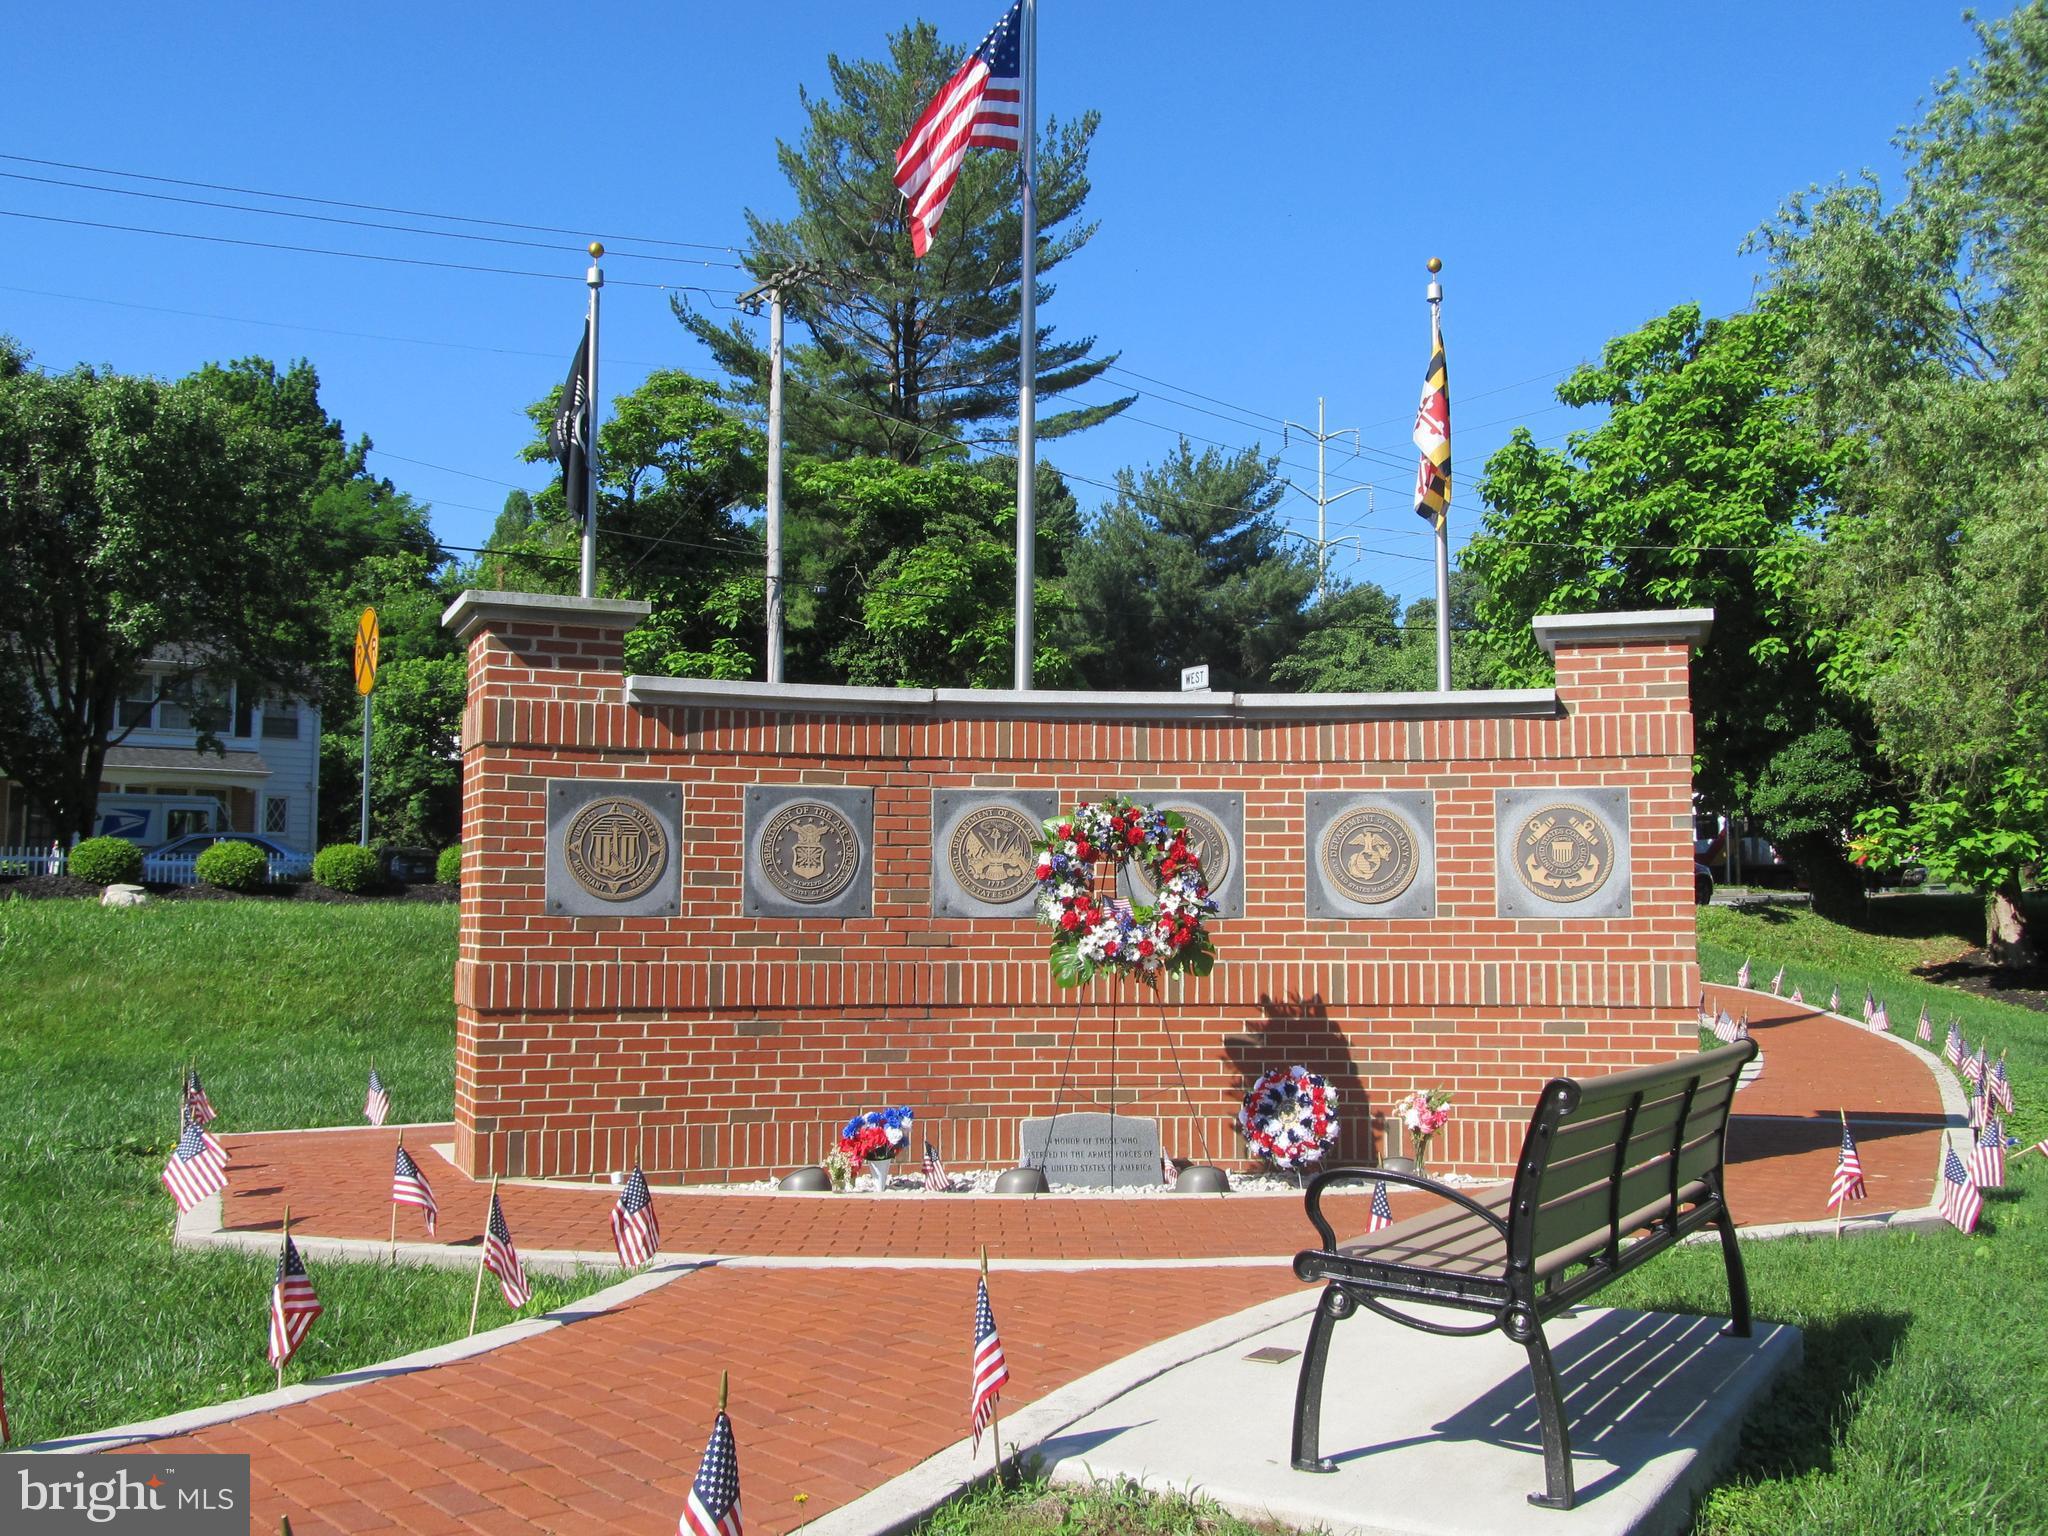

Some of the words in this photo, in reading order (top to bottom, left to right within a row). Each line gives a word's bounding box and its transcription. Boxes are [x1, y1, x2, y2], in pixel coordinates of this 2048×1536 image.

[1185, 670, 1204, 685] WEST
[573, 810, 598, 837] UNITED
[631, 809, 657, 837] STATES
[952, 809, 993, 849] DEPARTMENT
[997, 809, 1008, 817] OF
[1011, 813, 1027, 827] THE
[1192, 818, 1206, 831] THE
[1206, 828, 1220, 848] NAVY
[1330, 814, 1376, 858] DEPARTMENT
[1386, 822, 1398, 833] THE
[1397, 832, 1410, 858] NAVY
[763, 810, 793, 866] DEPARTMENT
[795, 806, 809, 815] OF
[813, 807, 834, 820] THE
[833, 819, 850, 837] AIR
[842, 839, 854, 873] FORCE
[574, 859, 607, 890] MERCHANT
[628, 863, 655, 888] MARINE
[953, 856, 971, 886] UNITED
[970, 885, 1003, 897] STATES
[987, 880, 1006, 888] 1775
[1333, 863, 1349, 885] UNITED
[1347, 882, 1371, 893] STATES
[1371, 881, 1394, 893] MARINE
[1393, 863, 1408, 882] CORPS
[1031, 1151, 1058, 1159] SERVED
[1143, 1150, 1153, 1158] OF
[1054, 1137, 1080, 1145] HONOR
[1083, 1137, 1092, 1145] OF
[1120, 1137, 1138, 1145] WHO
[1051, 1164, 1079, 1172] UNITED
[1080, 1164, 1106, 1172] STATES
[1119, 1164, 1153, 1172] AMERICA
